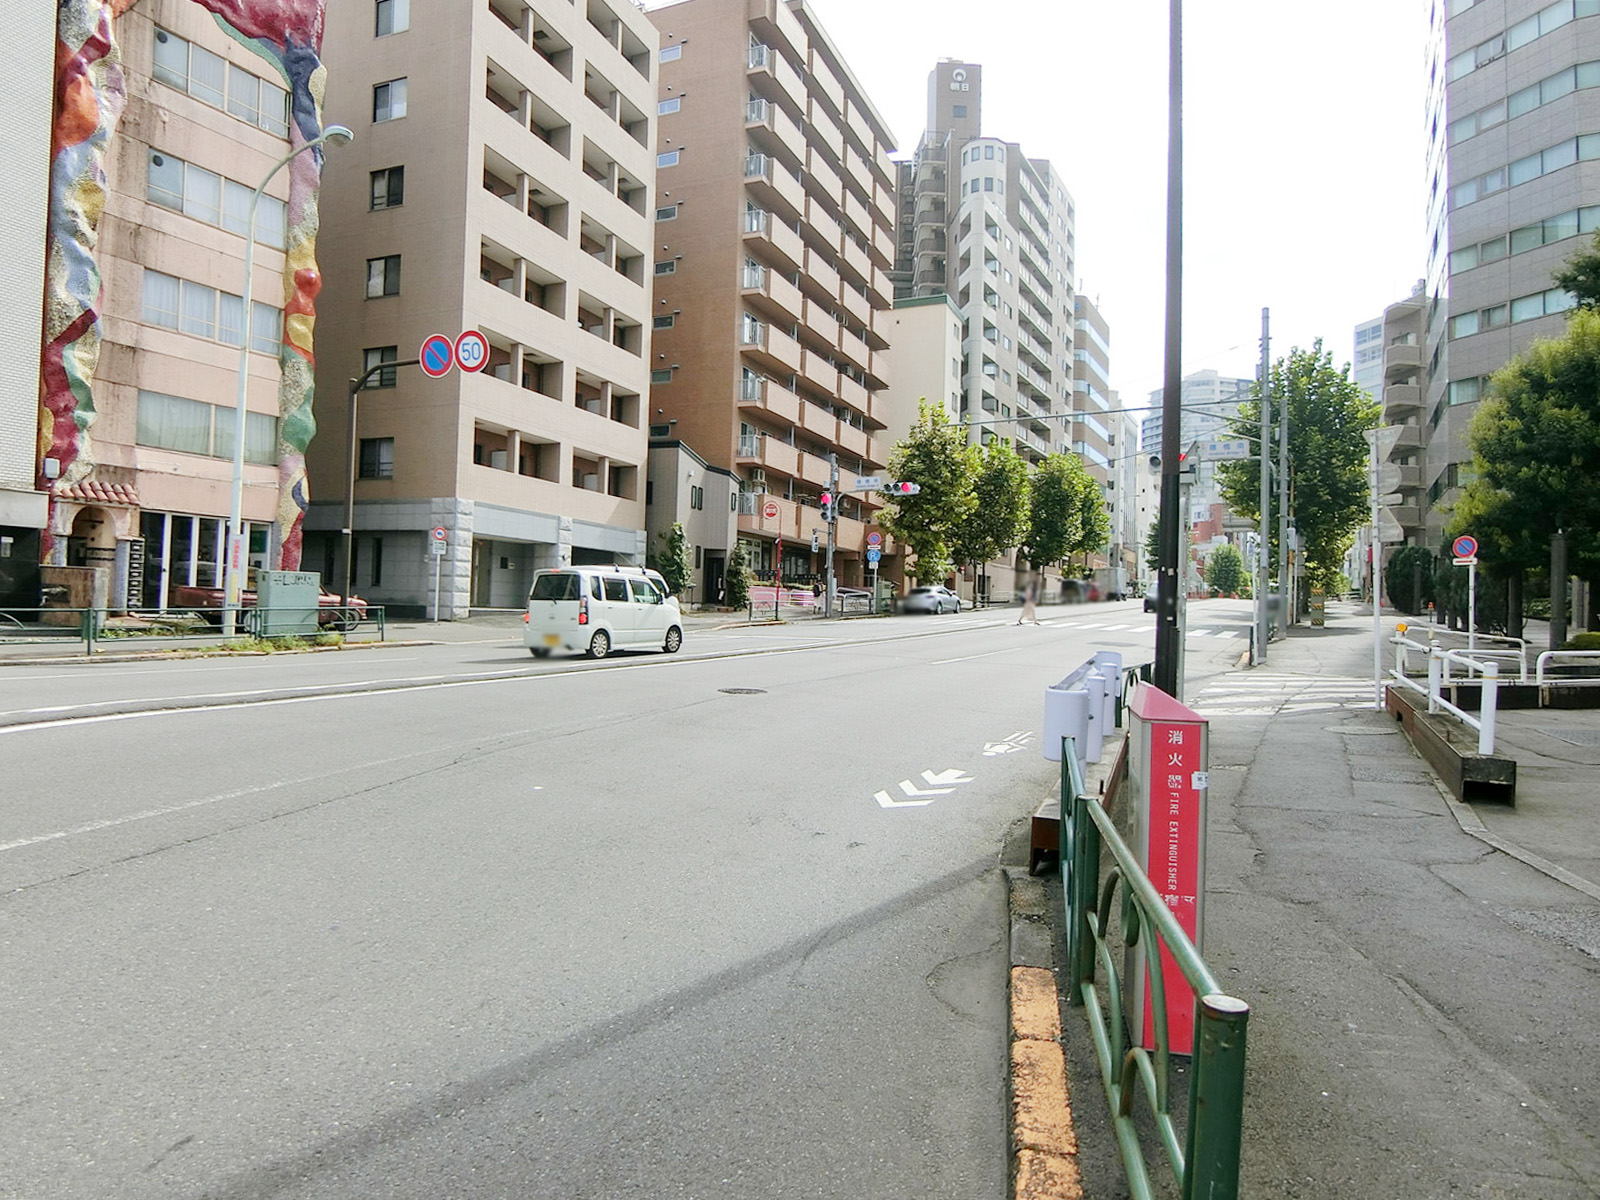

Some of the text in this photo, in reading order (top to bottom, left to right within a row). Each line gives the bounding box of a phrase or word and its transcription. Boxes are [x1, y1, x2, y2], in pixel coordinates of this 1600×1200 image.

[949, 82, 969, 91] 朝日
[462, 342, 481, 361] 50
[1168, 730, 1183, 789] 消火器
[1168, 792, 1179, 890] FIRE EXTINGUISHER
